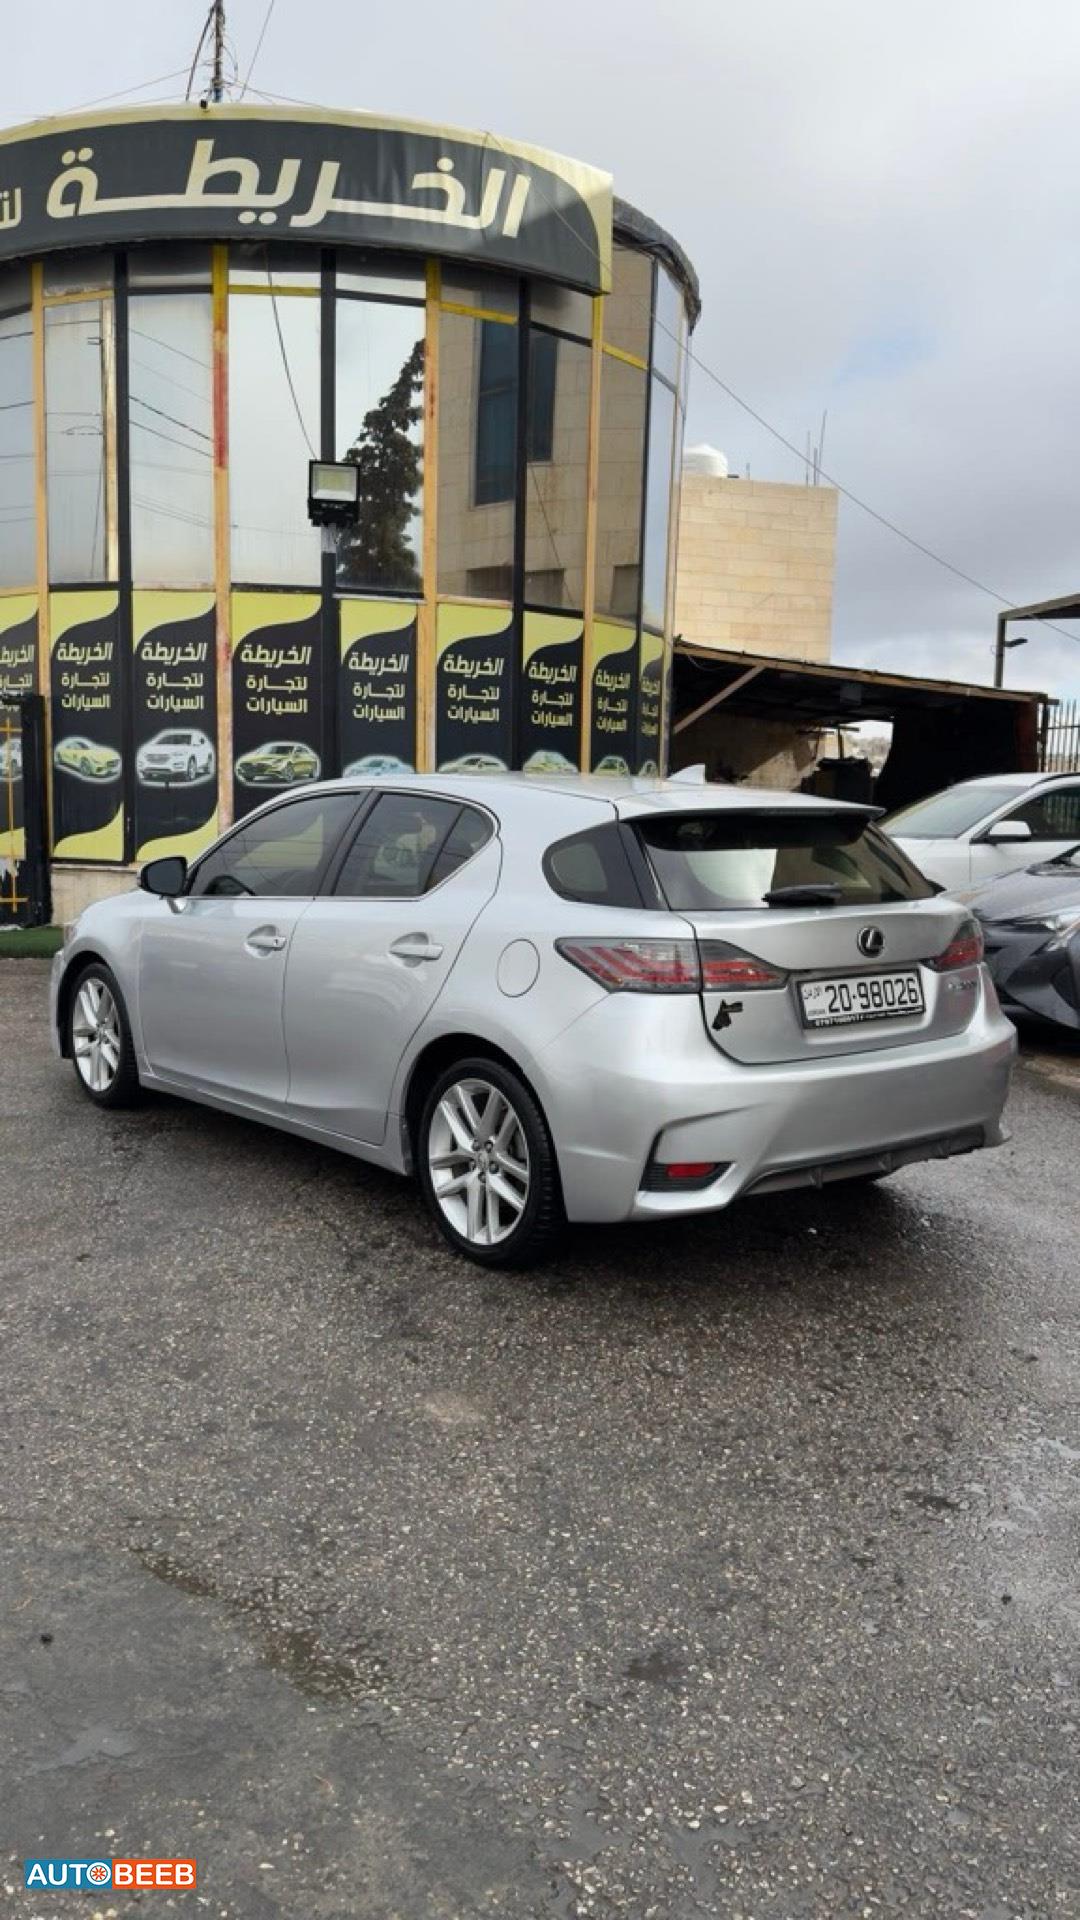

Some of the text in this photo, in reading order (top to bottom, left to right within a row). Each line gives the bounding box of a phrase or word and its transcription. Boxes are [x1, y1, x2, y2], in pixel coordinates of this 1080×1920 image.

[46, 137, 533, 238] الخريطة
[0, 644, 35, 668] الخريط
[57, 642, 113, 666] الخريطة
[141, 642, 208, 666] الخريطة
[240, 644, 312, 668] الخريطة
[349, 652, 410, 676] الخريطة
[444, 654, 504, 676] الخريطة
[528, 662, 577, 684] الخريطة
[61, 672, 110, 689] لتجارة
[146, 673, 204, 690] لتجارة
[246, 675, 308, 692] لتجارة
[353, 682, 406, 700] لتجارة
[448, 684, 500, 701] لتجارة
[62, 694, 110, 711] السيارات
[147, 695, 204, 712] السيارات
[247, 697, 308, 715] السيارات
[353, 704, 406, 722] السيارات
[448, 705, 500, 724] السيارات
